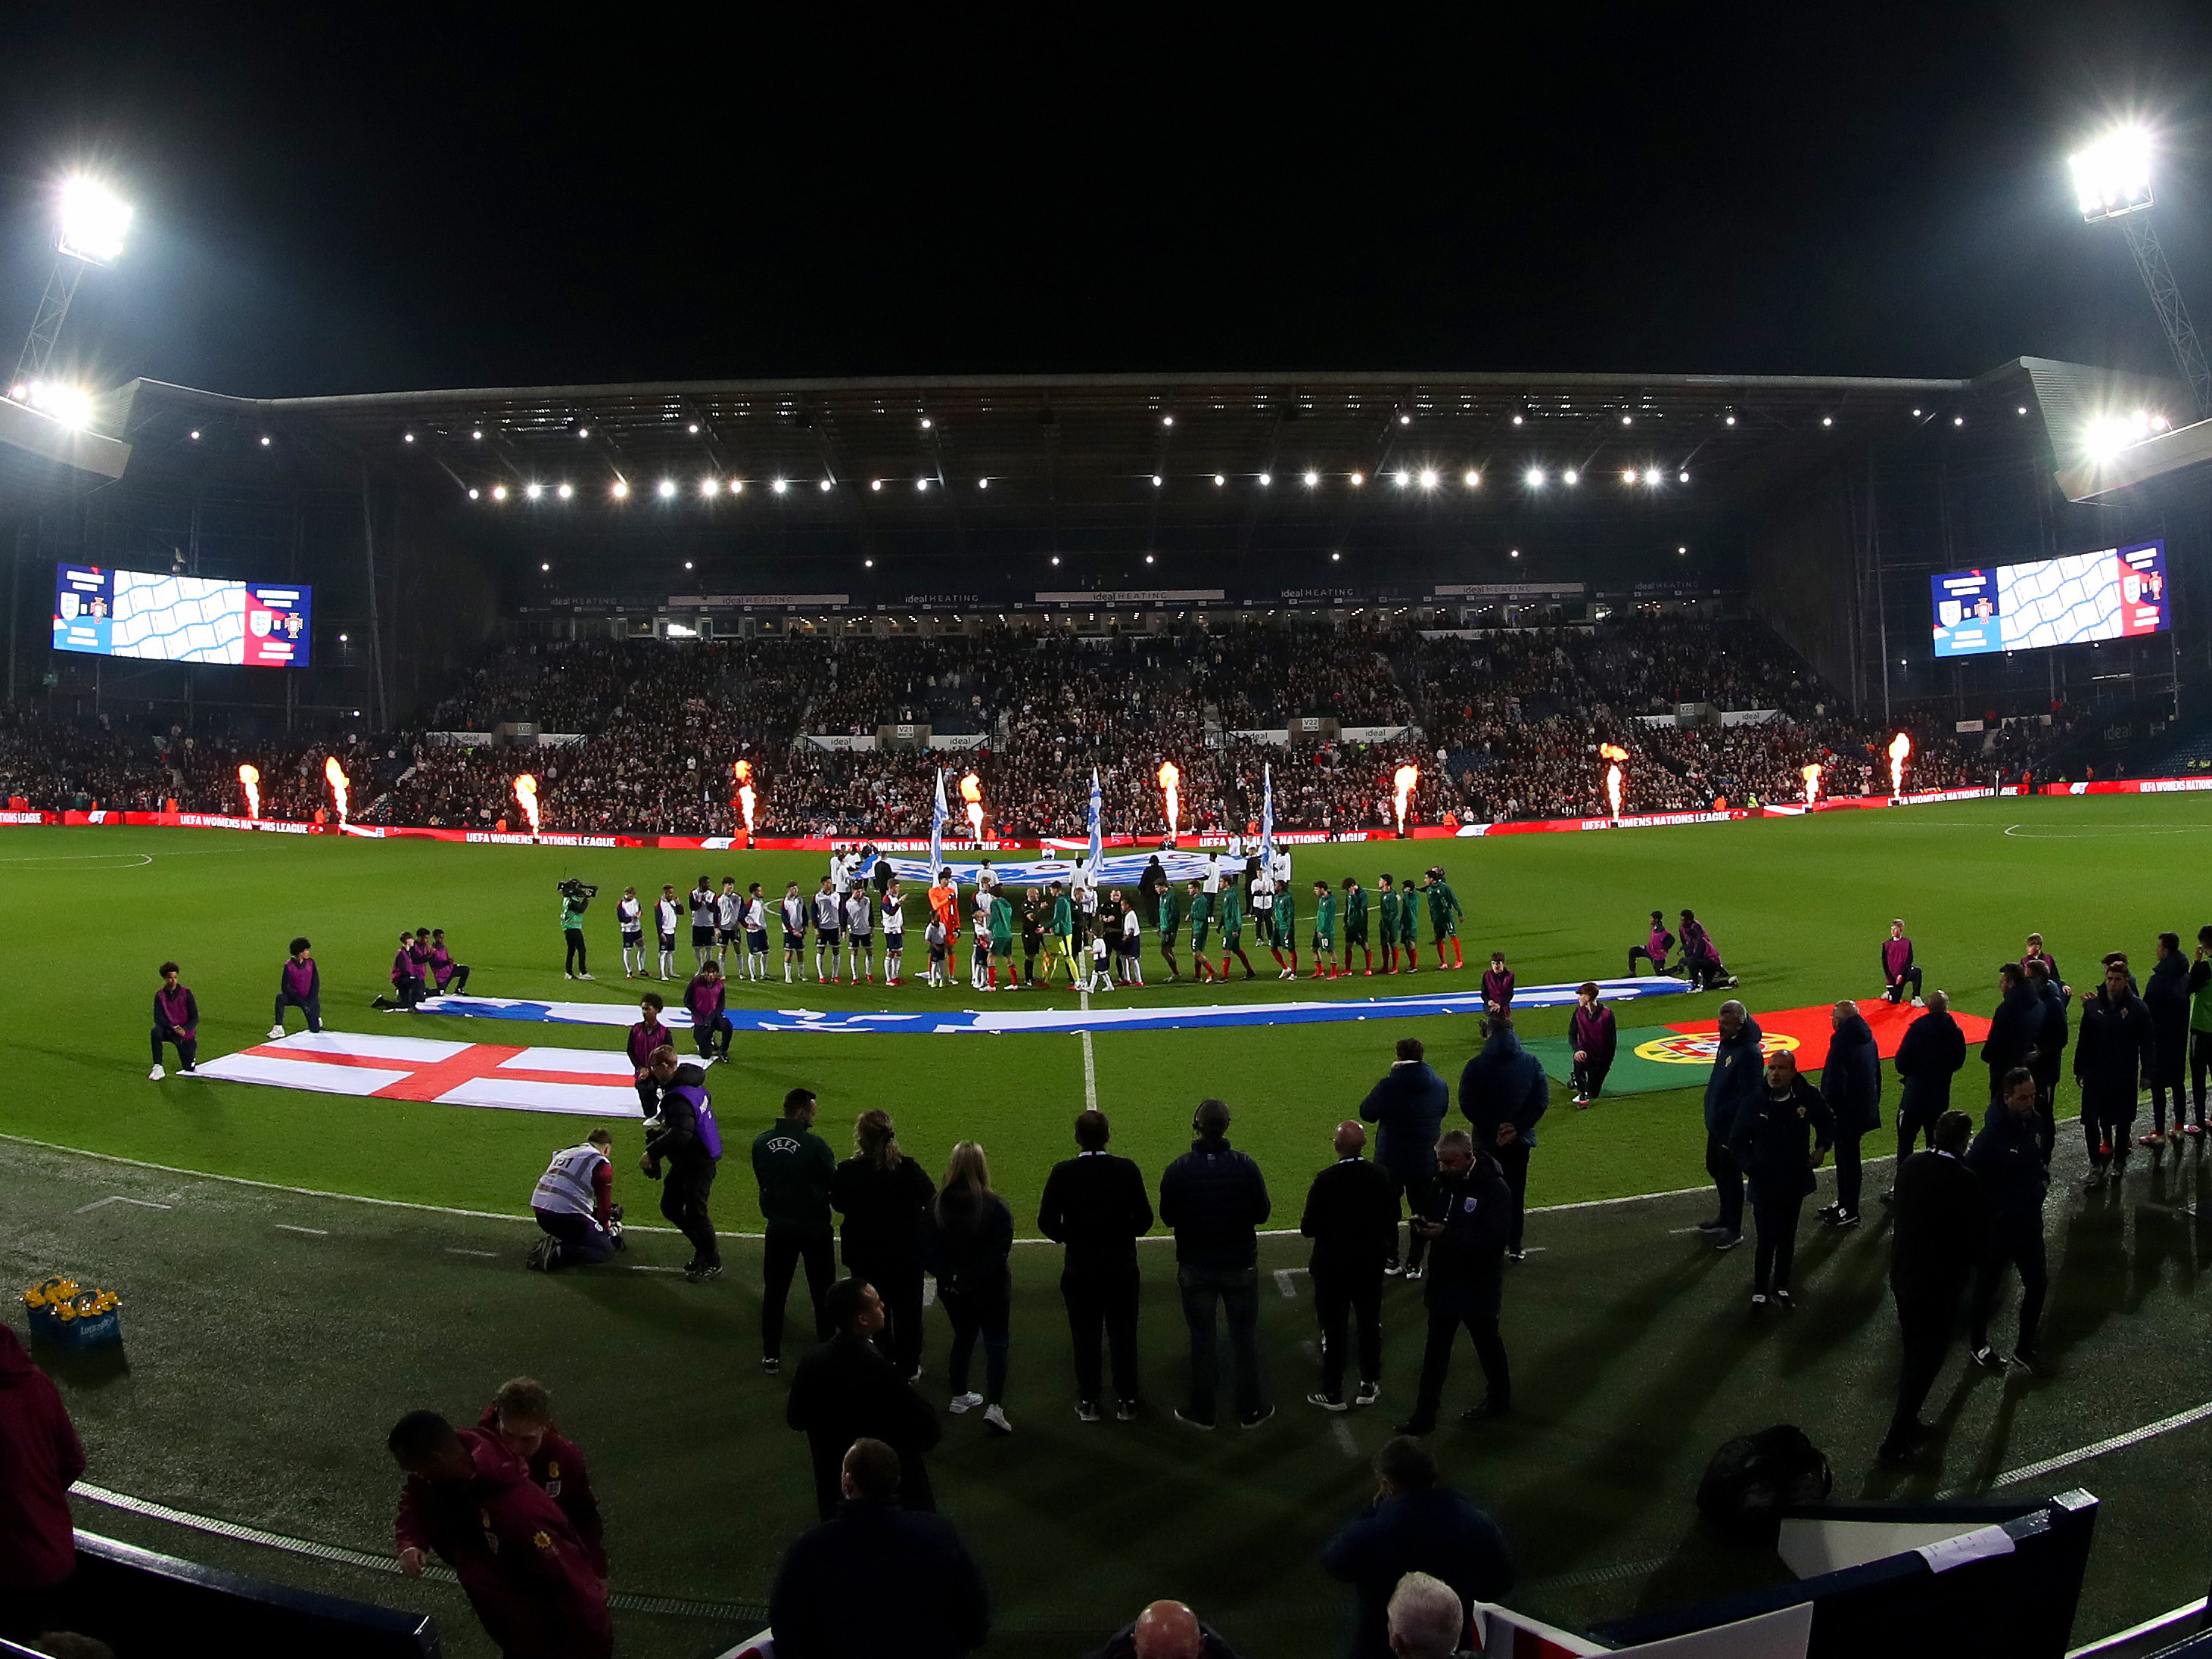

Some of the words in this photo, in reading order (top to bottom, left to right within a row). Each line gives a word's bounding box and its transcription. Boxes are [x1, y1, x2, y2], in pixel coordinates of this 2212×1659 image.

[1094, 593, 1115, 601] ideal
[1281, 589, 1303, 597] ideal
[1305, 588, 1354, 596] HEATING
[905, 594, 928, 603] ideal
[929, 594, 979, 603] HEATING
[830, 737, 851, 745] ideal
[950, 736, 971, 745] ideal
[1249, 732, 1268, 740] deal
[2140, 782, 2157, 792] UEFA
[2157, 780, 2186, 792] WOMENS
[2186, 779, 2212, 791] NATIONS
[1887, 797, 1909, 807] UFA
[1909, 792, 1946, 805] WOMENS
[1946, 789, 1980, 801] NATIONS
[17, 812, 42, 823] LEAGUE
[1582, 820, 1607, 830] UEFA
[1653, 813, 1694, 826] NATIONS
[1695, 811, 1731, 823] LEAGUE
[180, 815, 202, 825] UEFA
[202, 816, 241, 829] WOMENS
[241, 819, 275, 832] NAONS
[276, 822, 308, 834] LEAGUE
[466, 832, 490, 843] UEFA
[490, 833, 534, 845] WOMENS
[578, 836, 617, 848] LEAGUE
[1199, 837, 1227, 847] UEFA
[1279, 834, 1326, 845] NATIONS
[910, 842, 957, 851] NATNS
[1321, 938, 1329, 947] 10
[768, 1140, 798, 1152] UEFA
